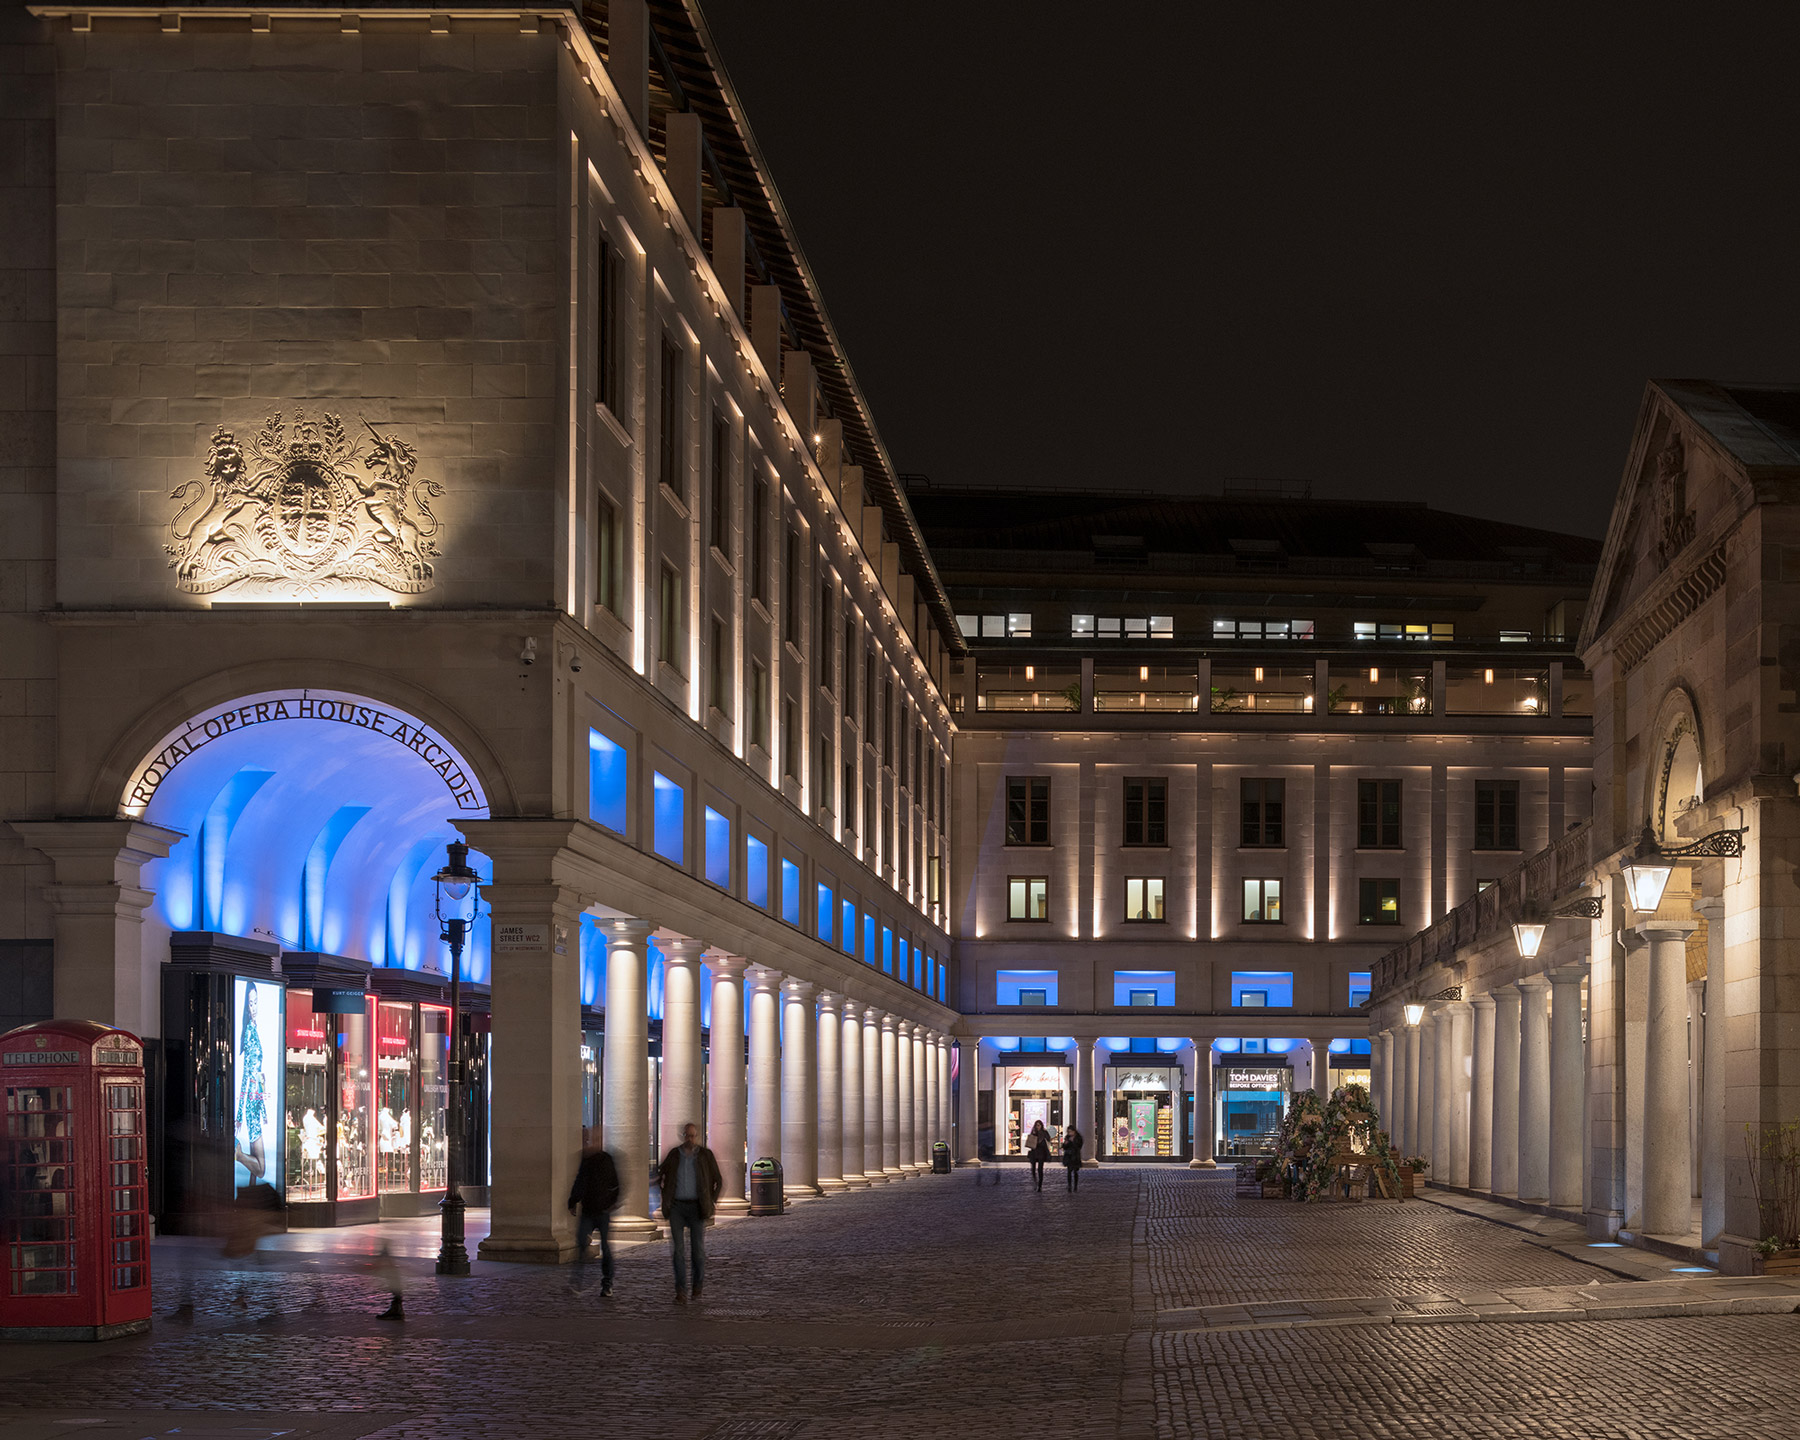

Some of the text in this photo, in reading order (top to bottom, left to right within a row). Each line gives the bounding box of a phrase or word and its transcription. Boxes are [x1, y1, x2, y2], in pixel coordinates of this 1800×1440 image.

[133, 700, 478, 809] ROYAL OPERA HOUSE ARCADE
[6, 1052, 78, 1064] TELEPHONE
[1230, 1074, 1278, 1082] TOM DAVIES
